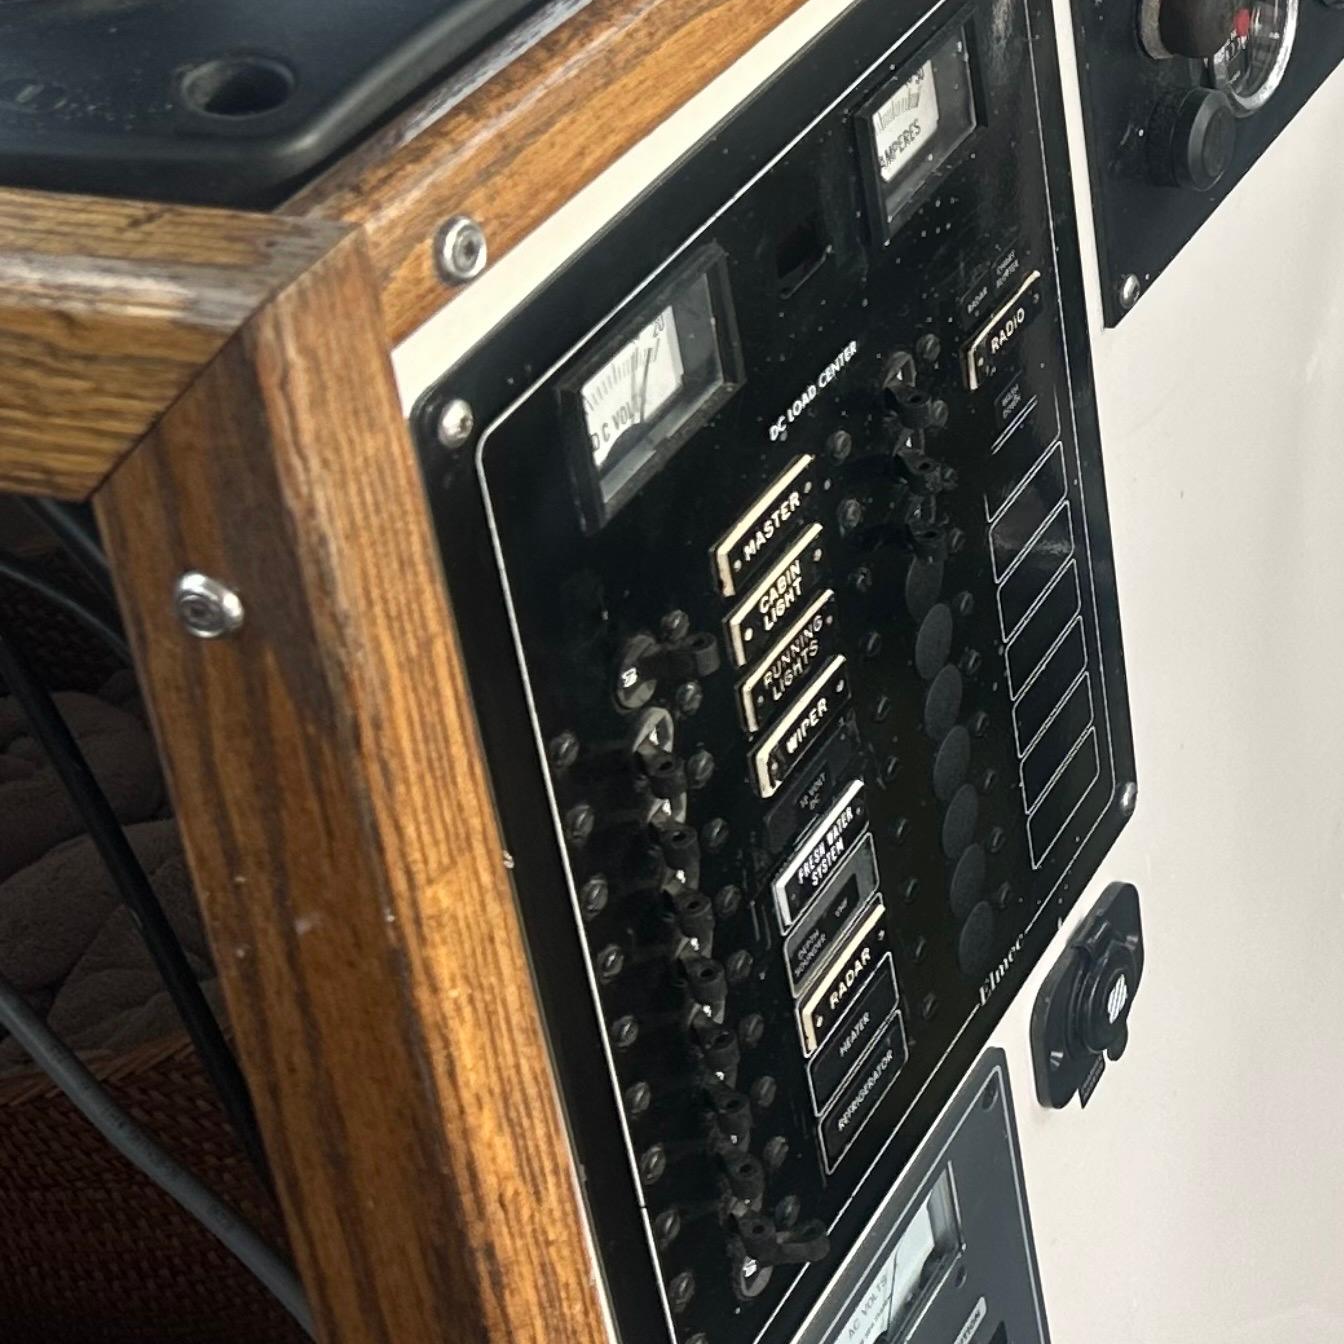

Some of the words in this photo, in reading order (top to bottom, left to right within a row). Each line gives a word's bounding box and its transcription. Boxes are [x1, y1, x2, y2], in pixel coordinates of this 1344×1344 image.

[990, 306, 1026, 355] RADIO
[768, 414, 788, 442] DC
[786, 384, 817, 423] LOAD
[817, 340, 857, 389] CENTER
[743, 490, 801, 562] MASTER
[758, 558, 802, 615] CABIN
[762, 575, 803, 632] LIGHT
[762, 613, 824, 691] RUNNING
[771, 638, 820, 702] LIGHTS
[785, 696, 829, 755] WIPER
[797, 840, 827, 885] FRESH
[825, 805, 854, 847] WATER
[811, 835, 845, 887] SYSTEM
[829, 946, 871, 1010] RADAR
[839, 1011, 871, 1058] HEATER
[837, 1048, 893, 1132] REFRIGERATOR
[847, 1317, 861, 1340] AC
